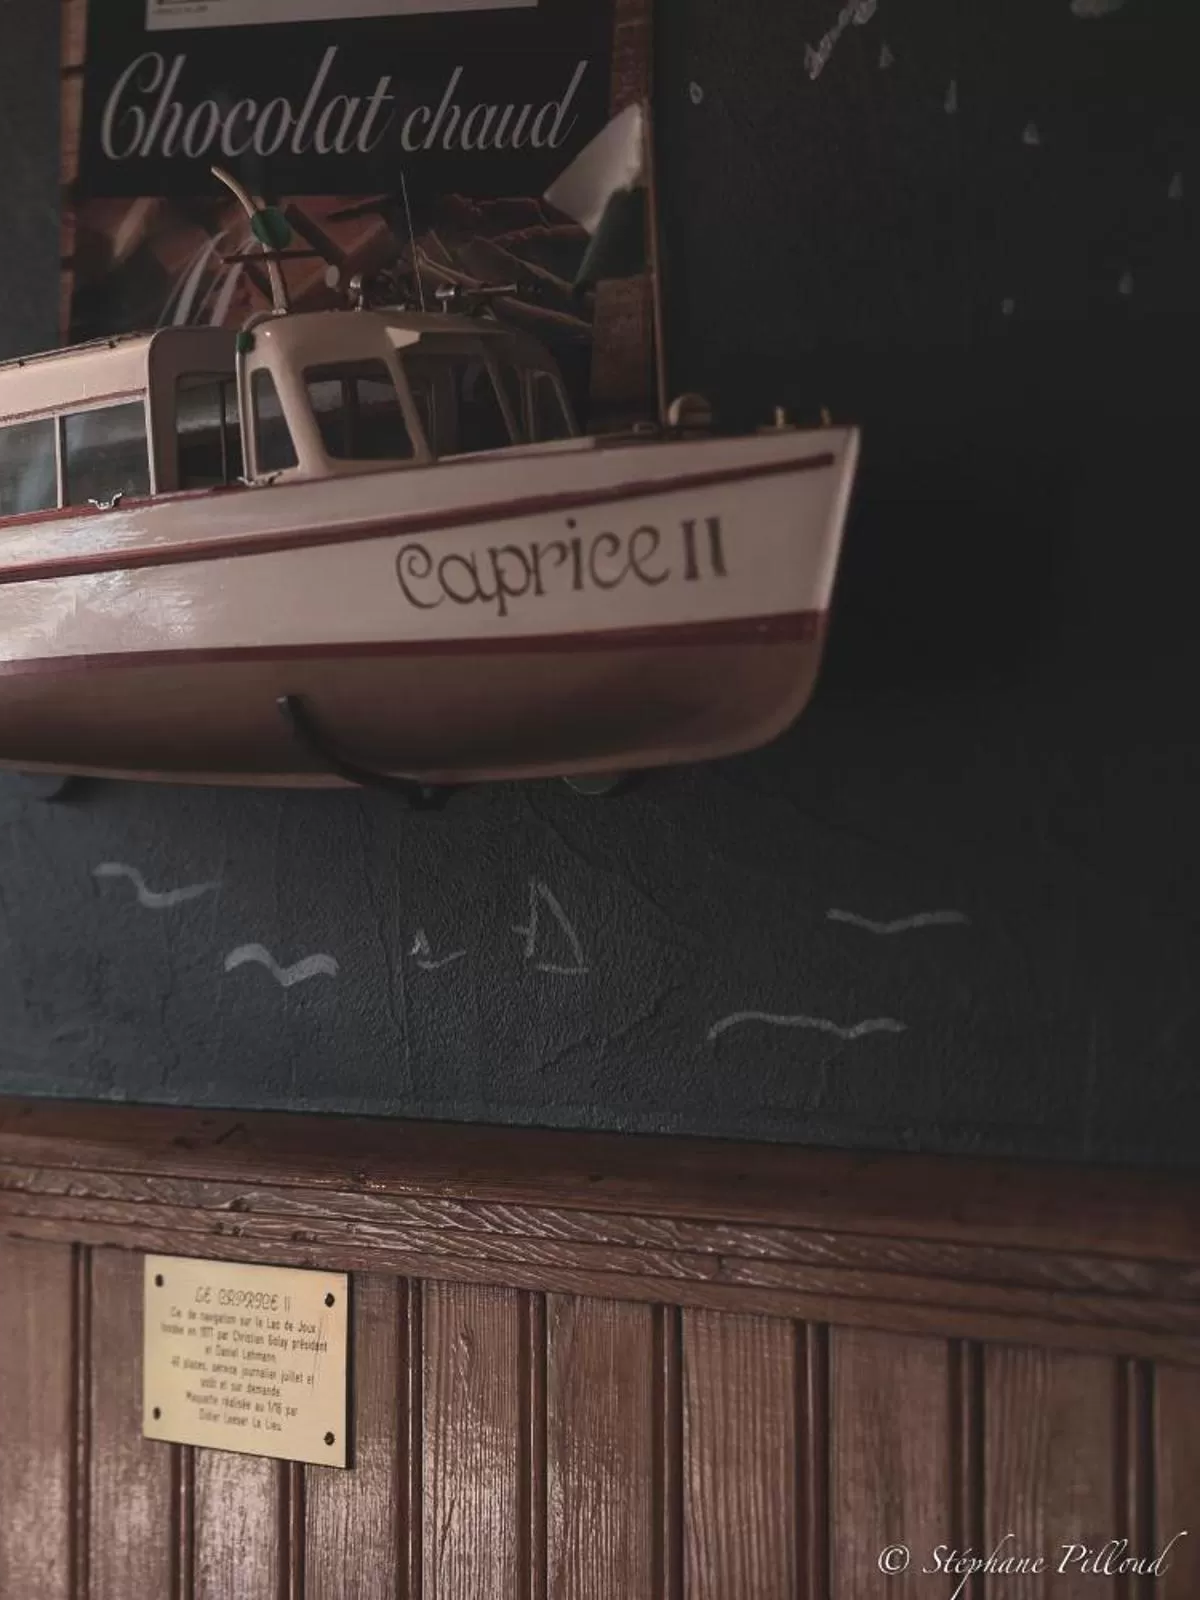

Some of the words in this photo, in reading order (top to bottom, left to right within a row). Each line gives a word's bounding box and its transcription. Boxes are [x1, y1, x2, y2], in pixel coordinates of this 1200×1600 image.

[102, 46, 396, 160] Chocolat
[400, 60, 588, 152] chaud
[395, 517, 671, 616] Caprice
[680, 516, 727, 581] II
